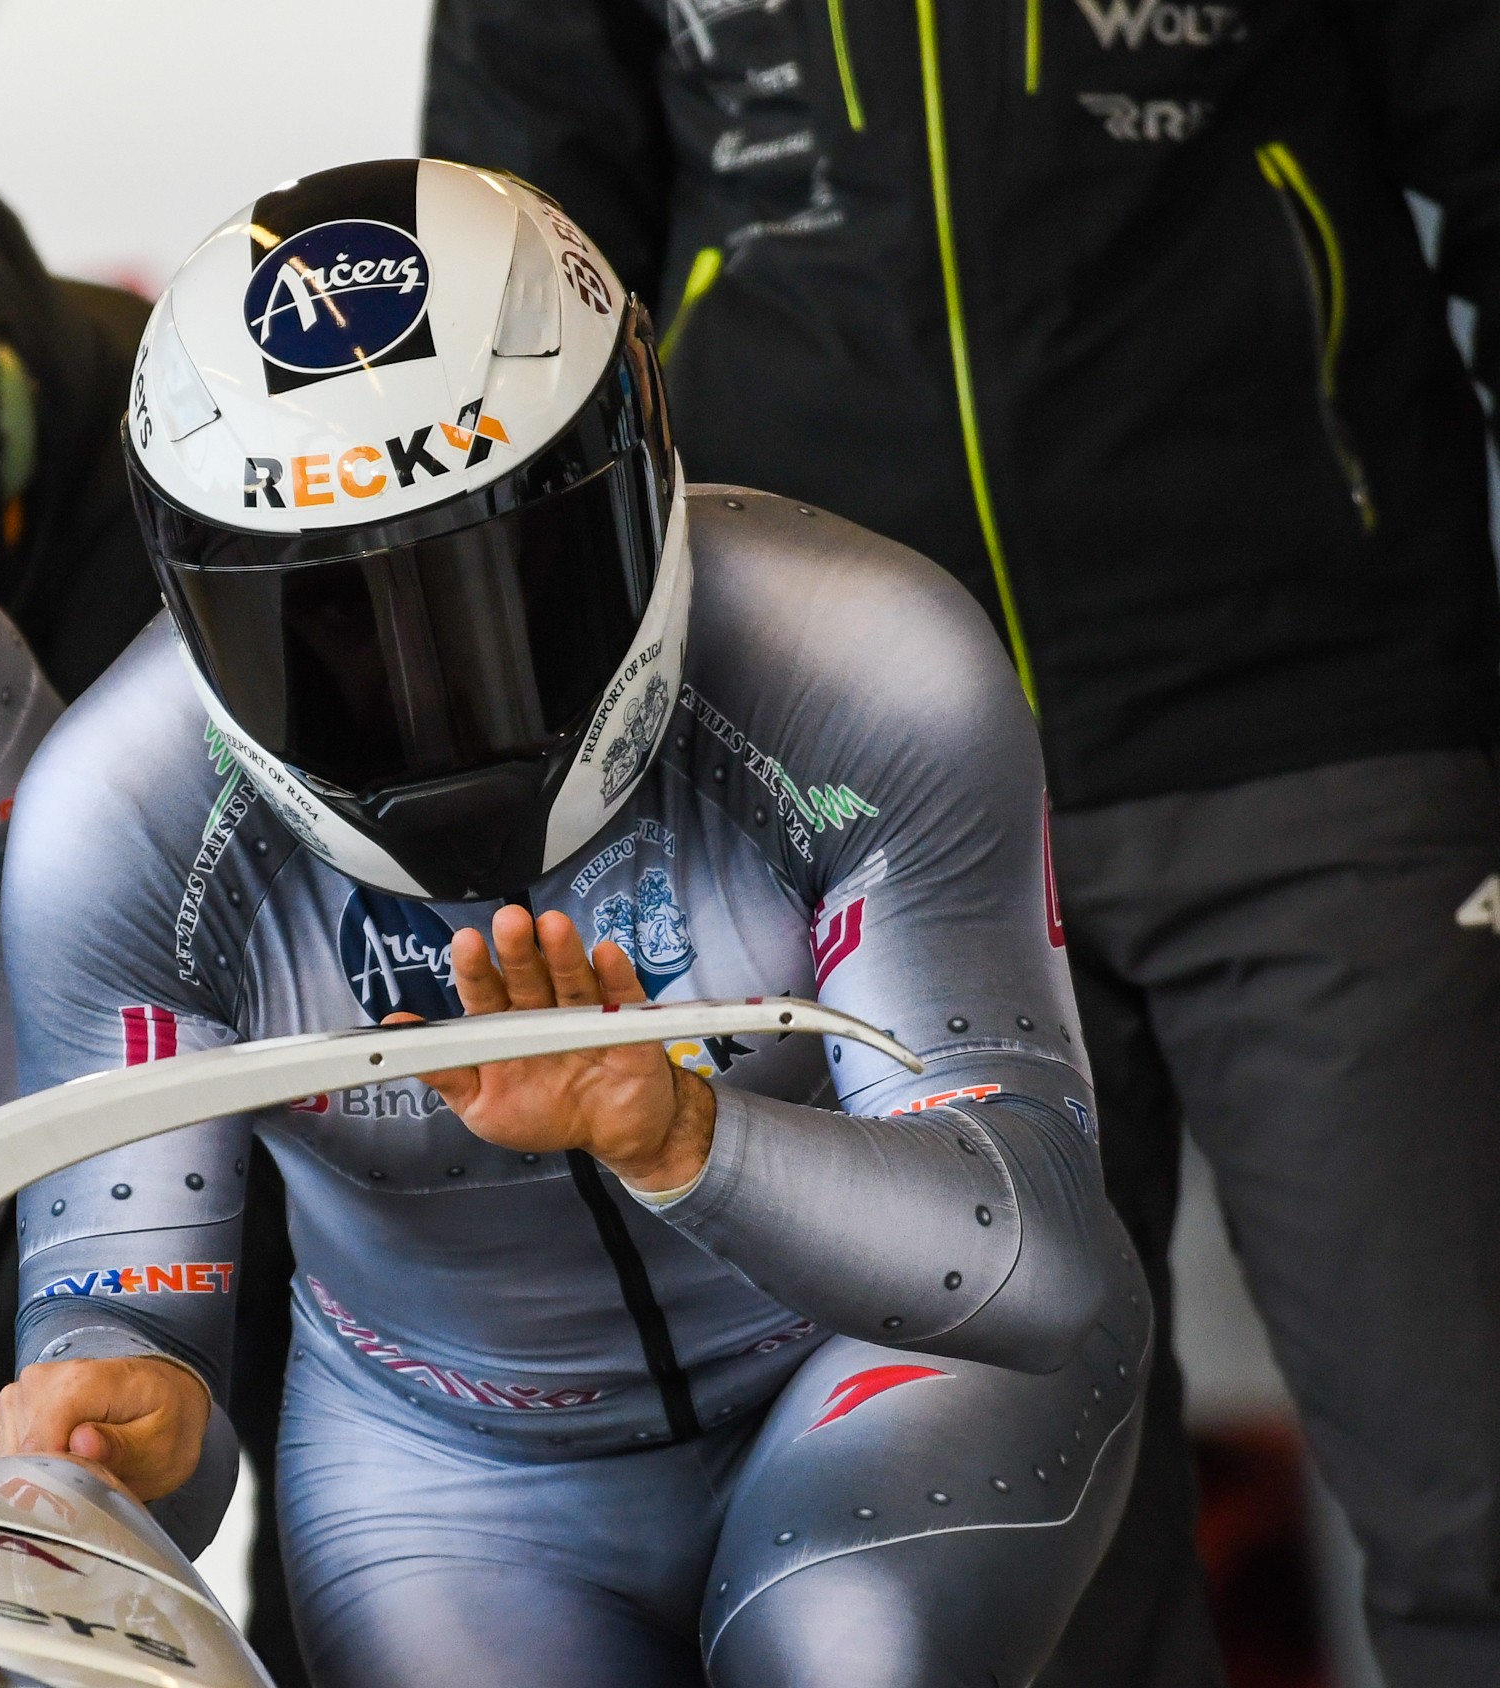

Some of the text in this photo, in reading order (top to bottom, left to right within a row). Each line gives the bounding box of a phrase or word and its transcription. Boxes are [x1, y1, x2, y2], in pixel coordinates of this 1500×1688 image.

[580, 678, 626, 764] FREEPORT
[624, 660, 639, 682] OF
[268, 767, 286, 786] OF
[286, 786, 319, 821] RIGA
